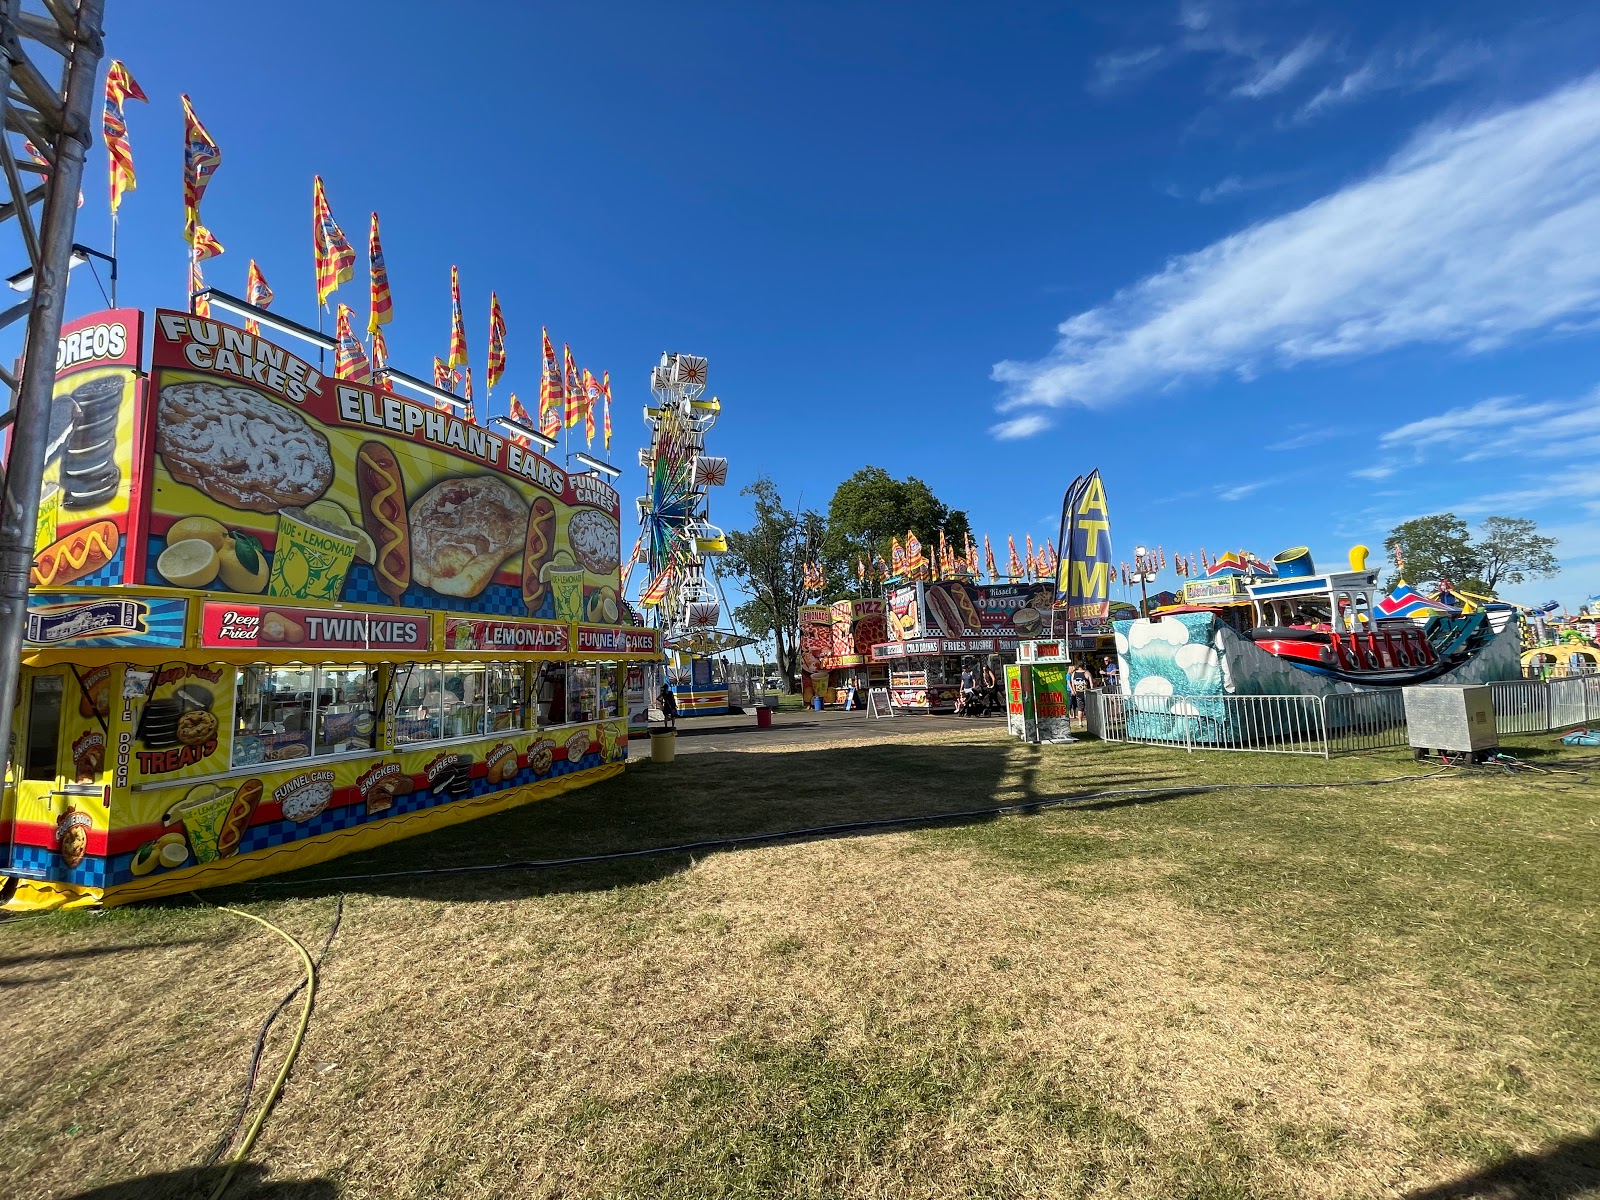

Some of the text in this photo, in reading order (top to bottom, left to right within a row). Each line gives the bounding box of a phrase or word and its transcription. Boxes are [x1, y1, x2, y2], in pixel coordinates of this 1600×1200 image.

[159, 315, 323, 397] FUNNEL
[185, 343, 308, 402] CAKES
[338, 387, 564, 495] ELEPHANT EARS
[569, 476, 619, 505] FUNNEL
[576, 489, 614, 513] CAKES
[303, 529, 354, 558] LEMONADE
[1071, 477, 1110, 598] ATM
[223, 611, 260, 630] Deep
[1073, 603, 1101, 618] HERE
[219, 626, 259, 640] Fried
[305, 616, 418, 643] TWINKIES
[484, 626, 562, 646] LEMONADE
[579, 632, 653, 648] FUNNEL CAKES
[942, 641, 966, 651] FRIES
[1037, 666, 1060, 678] NEED
[1040, 672, 1063, 686] CASH
[1009, 678, 1023, 715] ATM
[1039, 691, 1064, 704] ATM
[385, 699, 393, 747] DRINKS
[1038, 704, 1067, 718] HERE
[74, 735, 103, 761] SNICKERS
[116, 733, 131, 788] DOUGH
[136, 732, 218, 775] TREATS
[360, 764, 400, 796] SNICKERS
[428, 754, 458, 782] OREOS
[275, 775, 310, 802] FUNNEL
